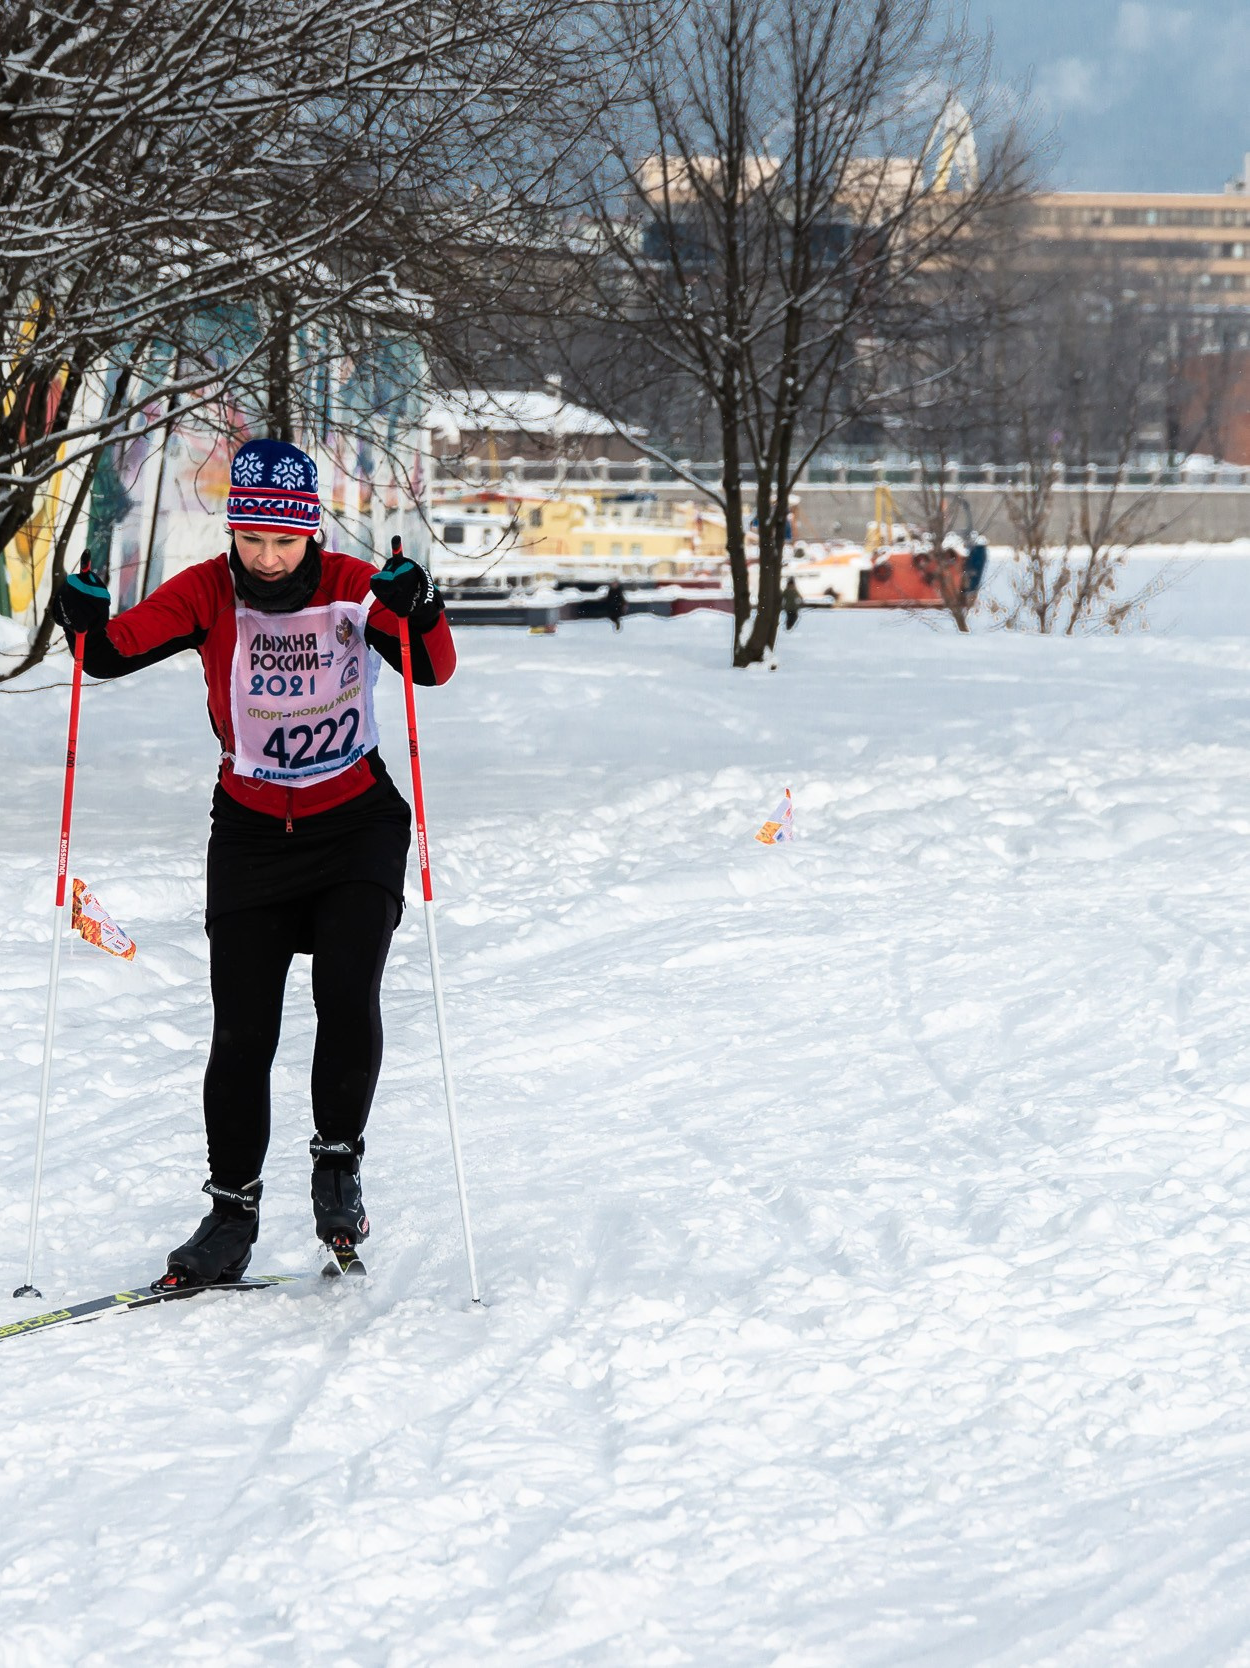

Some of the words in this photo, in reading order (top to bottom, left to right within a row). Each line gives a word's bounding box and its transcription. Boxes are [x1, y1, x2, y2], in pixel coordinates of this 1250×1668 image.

[233, 497, 309, 520] РОССИИ
[249, 632, 318, 653] ЛЫЖНЯ
[250, 652, 320, 673] РОССИИ
[248, 674, 315, 697] 2021
[247, 707, 283, 721] СПОРТ
[292, 700, 334, 718] НОРМА
[262, 707, 360, 770] 4222
